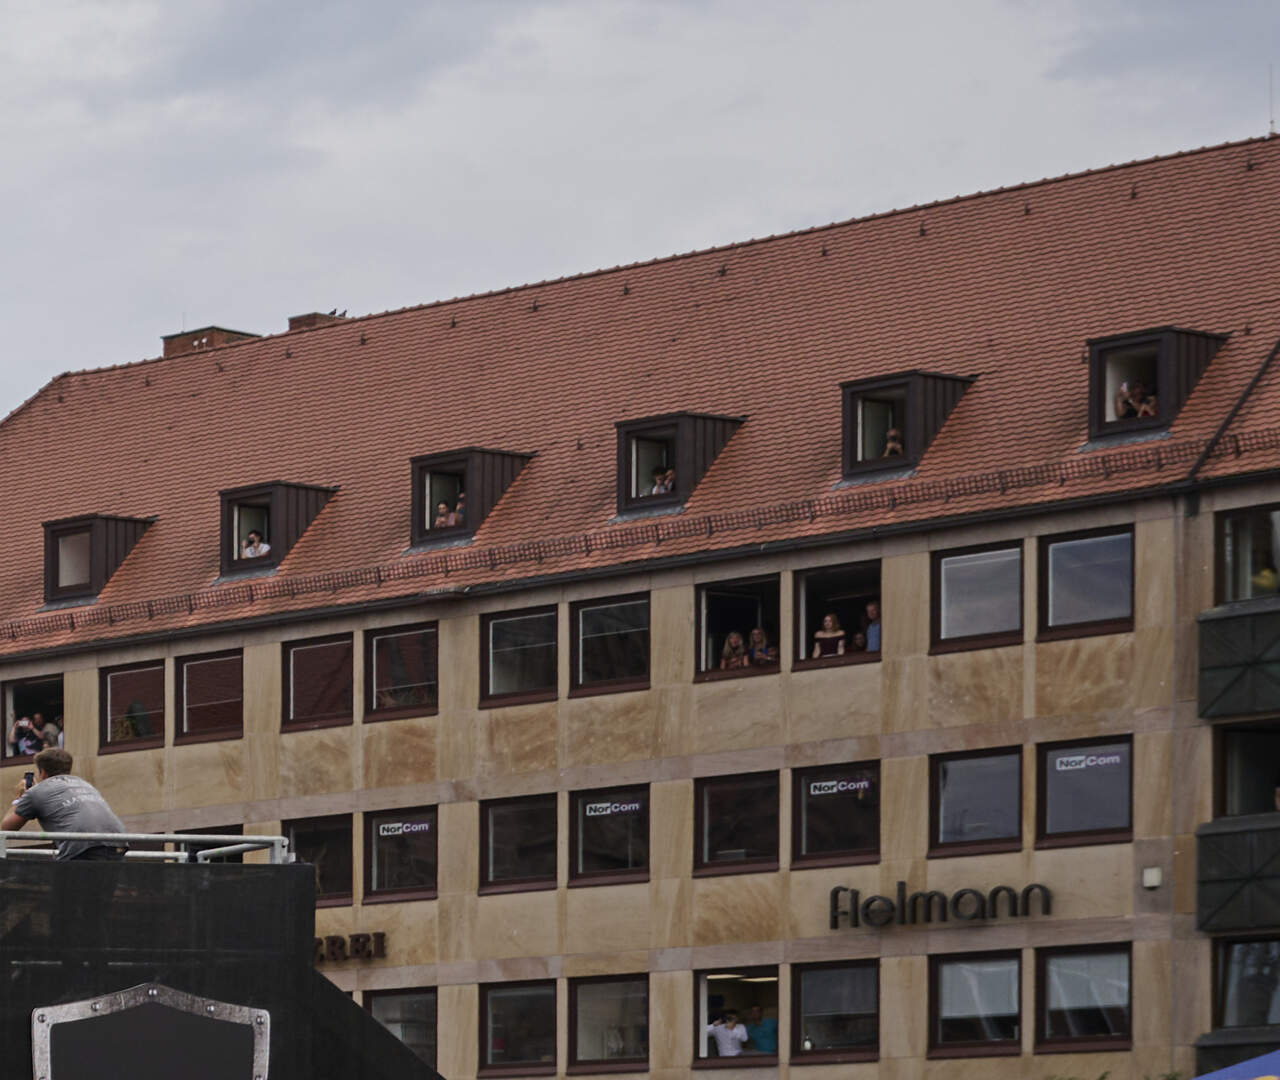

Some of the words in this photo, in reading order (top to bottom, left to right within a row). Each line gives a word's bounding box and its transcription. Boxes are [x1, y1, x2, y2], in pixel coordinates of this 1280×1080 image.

[1055, 755, 1120, 771] NorCom
[810, 780, 869, 796] NorCom
[586, 802, 640, 816] NorCom
[379, 822, 430, 836] NorCom
